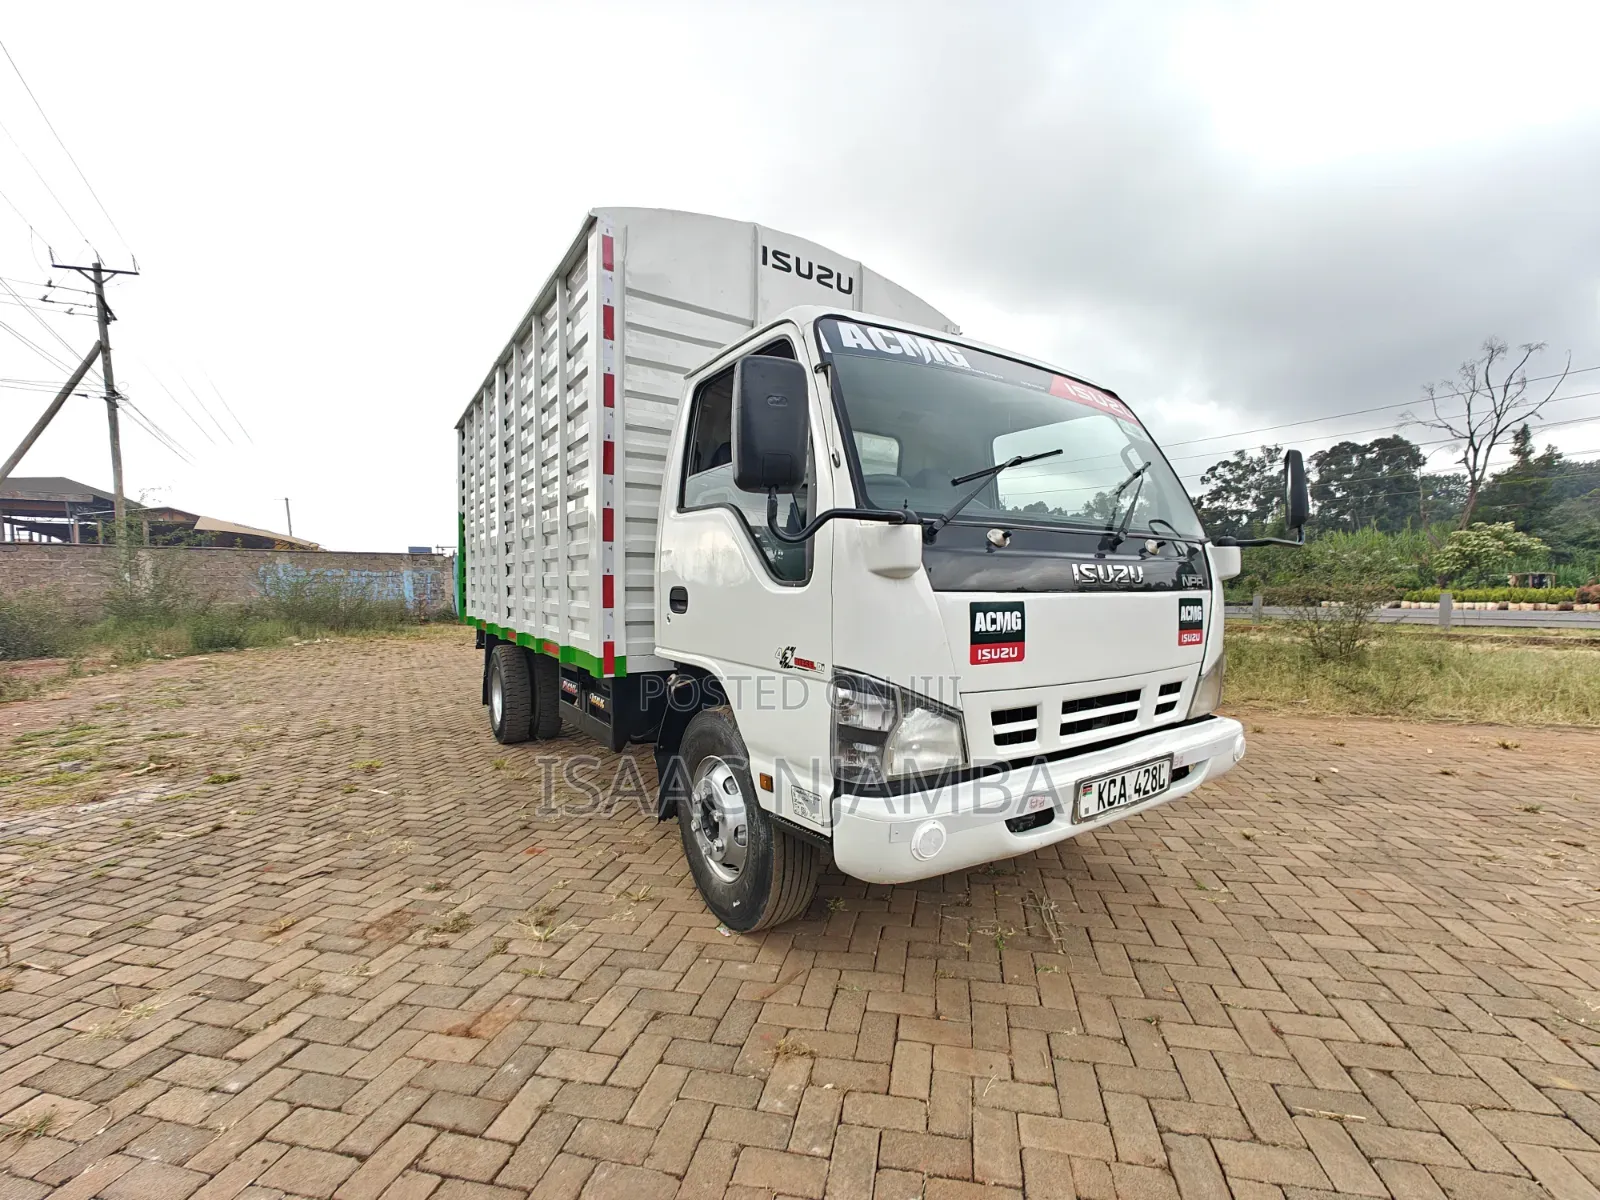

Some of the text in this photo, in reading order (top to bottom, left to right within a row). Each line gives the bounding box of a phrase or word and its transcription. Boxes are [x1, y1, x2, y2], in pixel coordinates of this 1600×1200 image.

[762, 245, 853, 295] ISUZU
[837, 321, 971, 369] ACMG
[1063, 382, 1137, 421] ISUZU
[1071, 563, 1144, 584] ISUZU
[1181, 575, 1204, 587] NPR
[974, 610, 1022, 635] ACMG
[1180, 605, 1203, 622] ACMG
[1181, 632, 1201, 643] ISUZU
[977, 646, 1018, 661] ISUZU
[1097, 763, 1166, 811] KCA 428L
